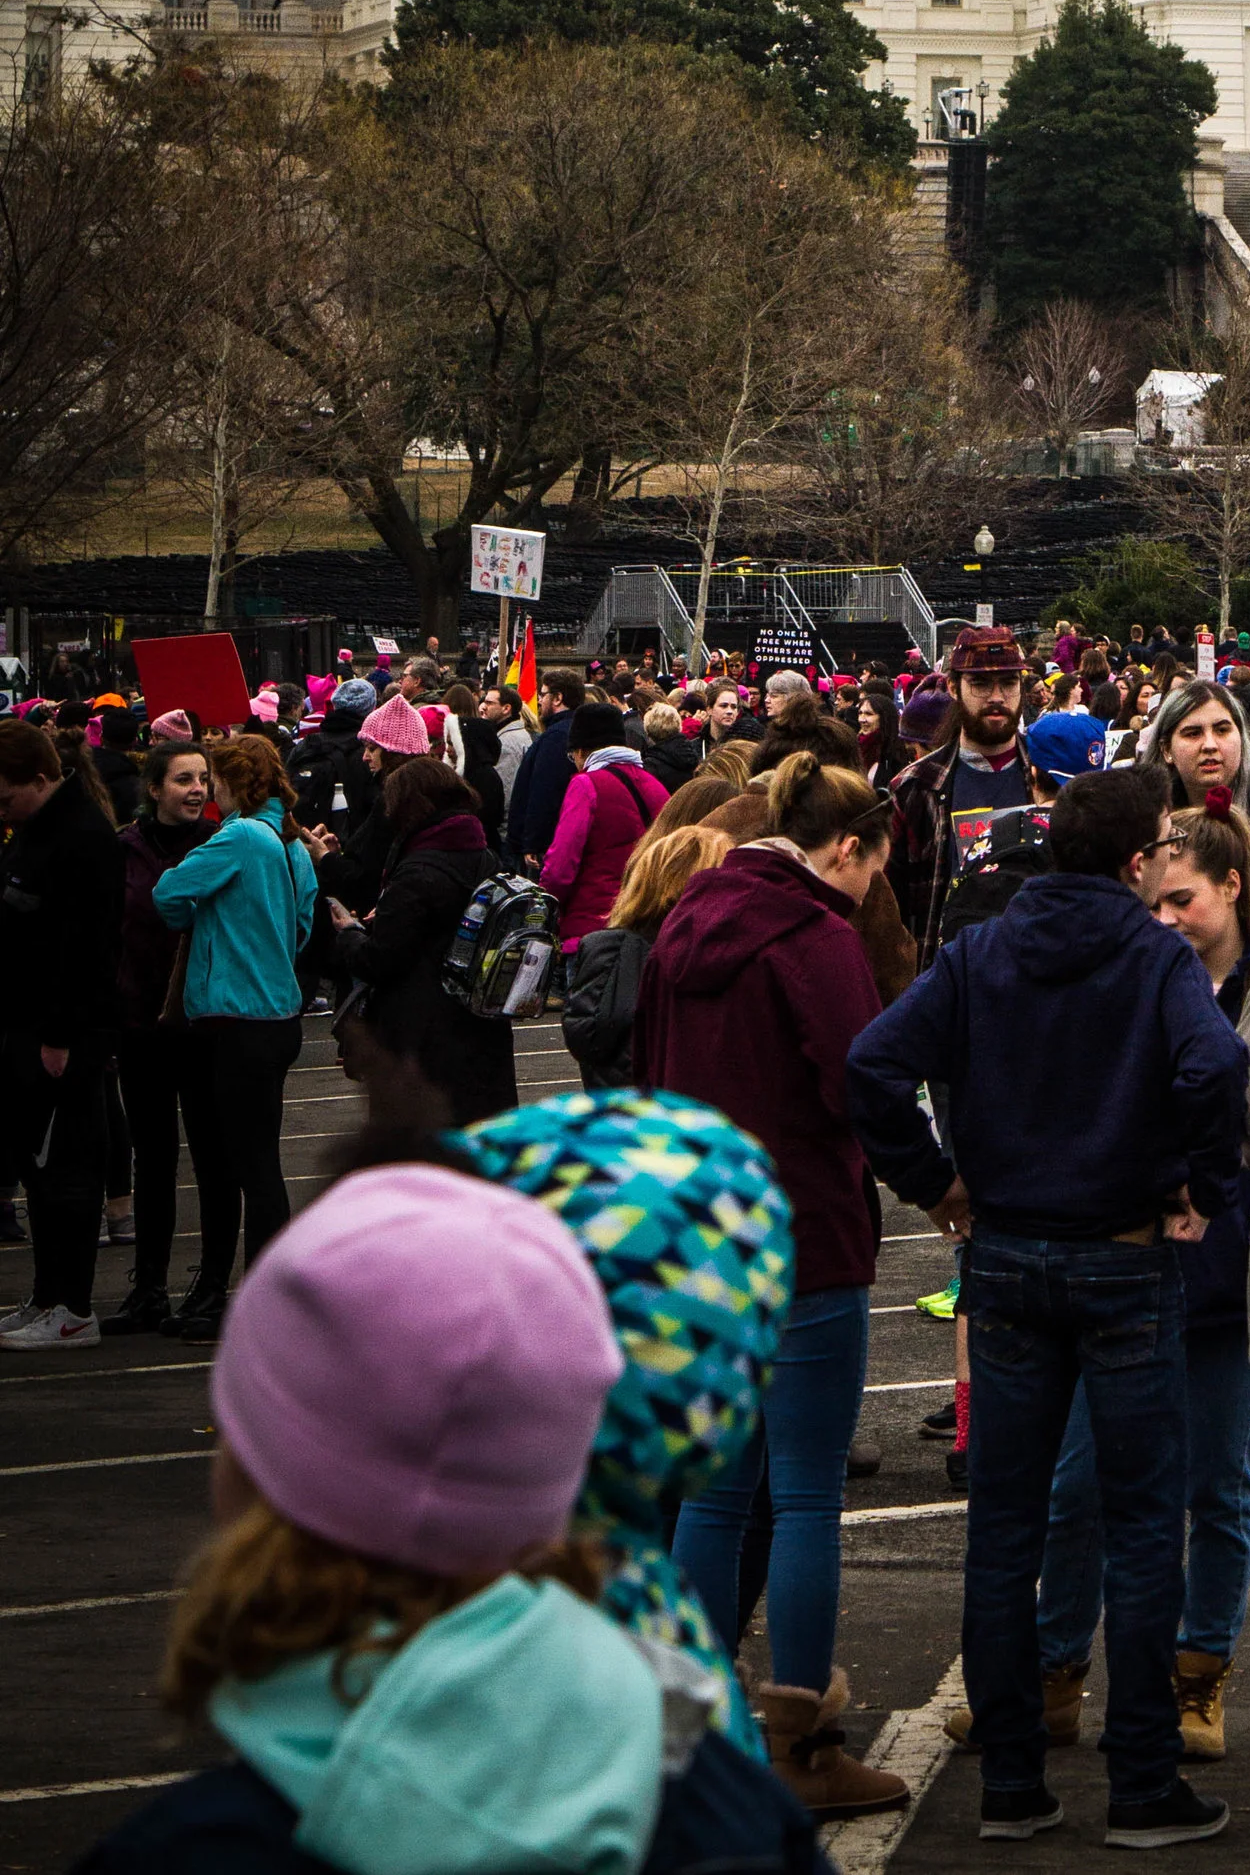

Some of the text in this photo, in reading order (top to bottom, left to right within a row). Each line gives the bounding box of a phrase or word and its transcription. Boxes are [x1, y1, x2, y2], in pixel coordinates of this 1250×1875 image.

[784, 639, 811, 647] WHEN
[754, 646, 791, 655] OTHERS
[756, 655, 810, 665] OPPRESSED
